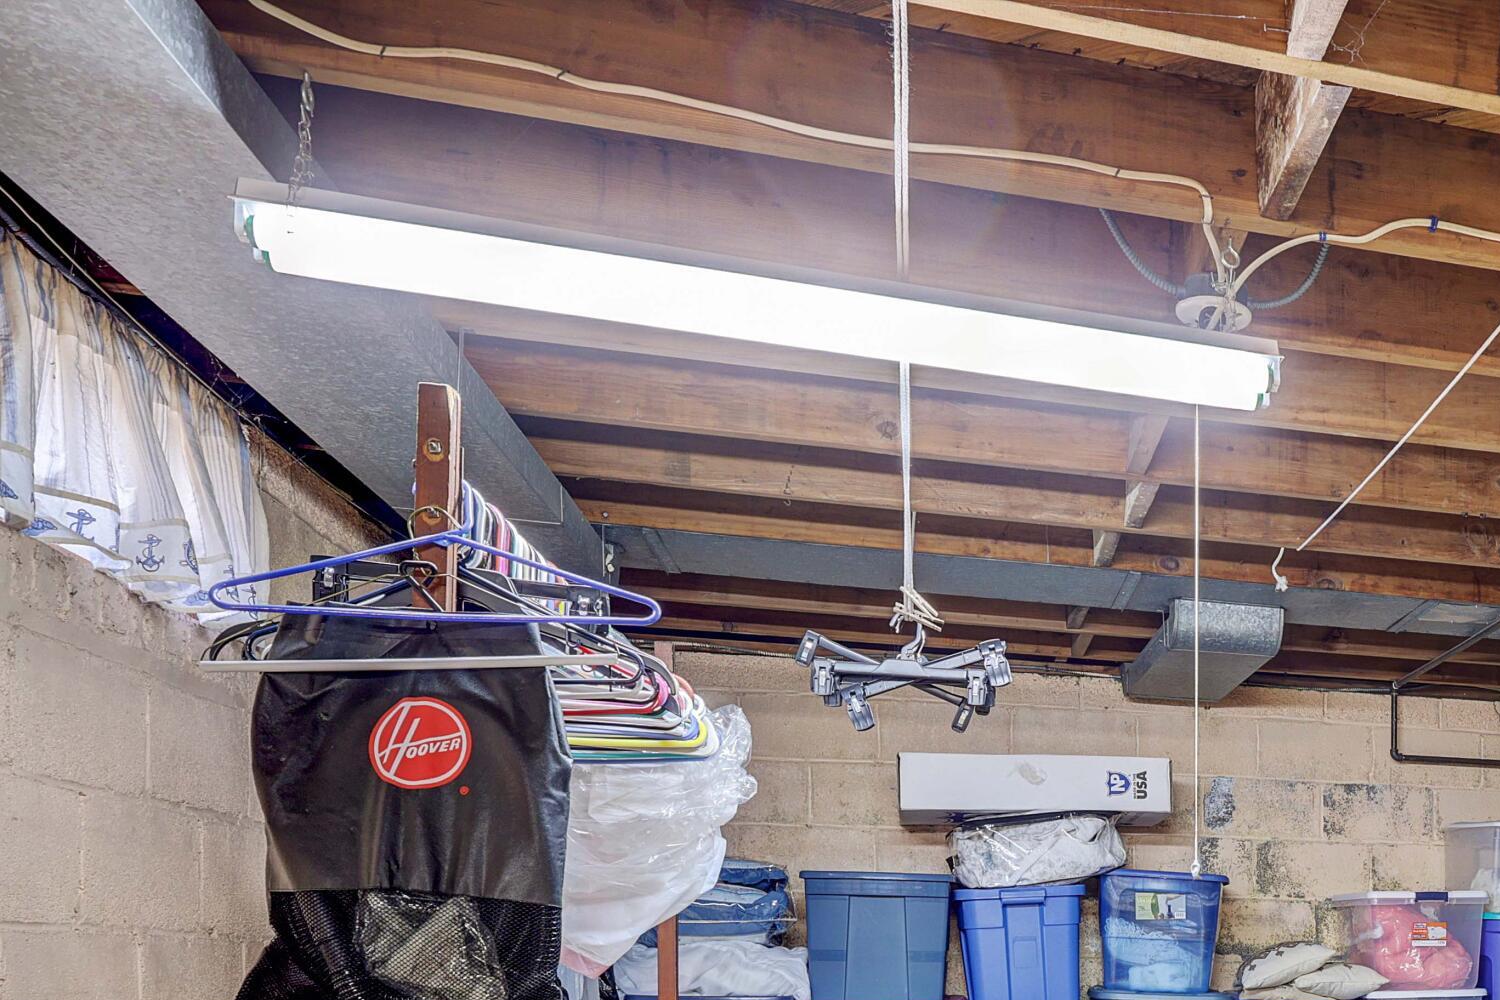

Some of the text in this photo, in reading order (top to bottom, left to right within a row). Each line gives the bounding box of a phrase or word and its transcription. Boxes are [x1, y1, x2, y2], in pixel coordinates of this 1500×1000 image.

[377, 703, 461, 777] HOOVER
[1110, 774, 1126, 792] NP
[1136, 771, 1148, 799] USA
